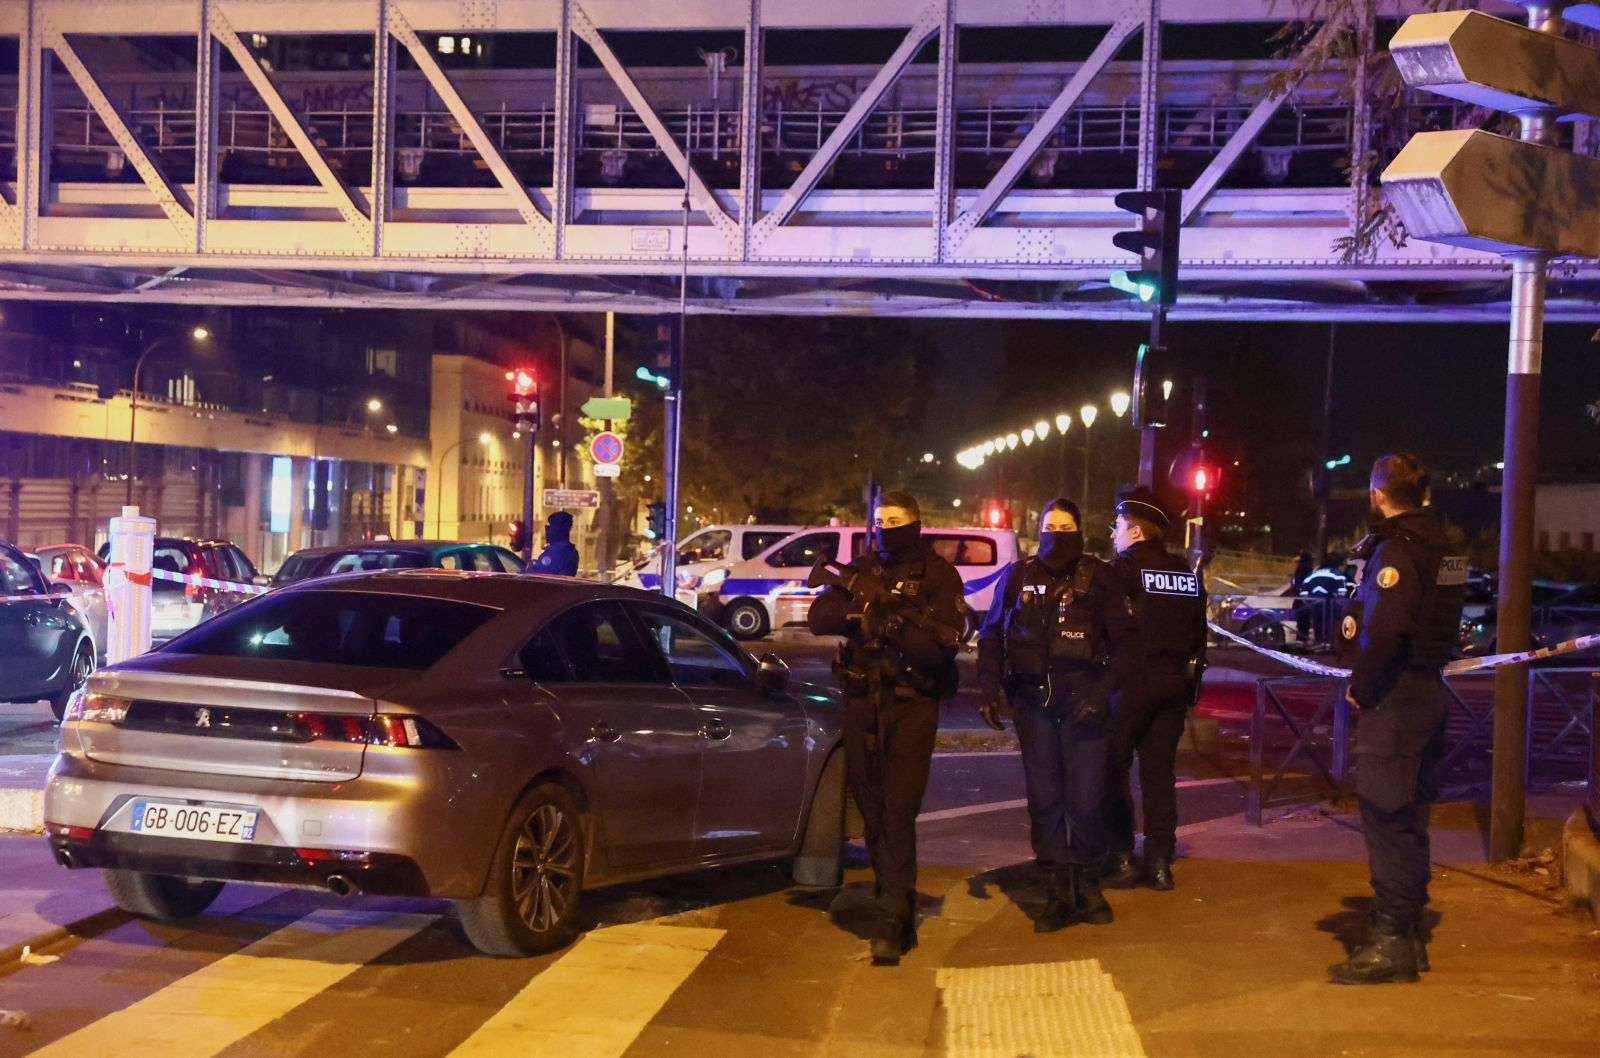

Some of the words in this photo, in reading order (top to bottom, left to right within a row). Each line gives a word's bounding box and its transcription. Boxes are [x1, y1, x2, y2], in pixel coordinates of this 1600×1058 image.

[1144, 573, 1196, 592] POLICE
[1061, 630, 1085, 639] POLICE
[145, 807, 242, 835] GB-006-EZ
